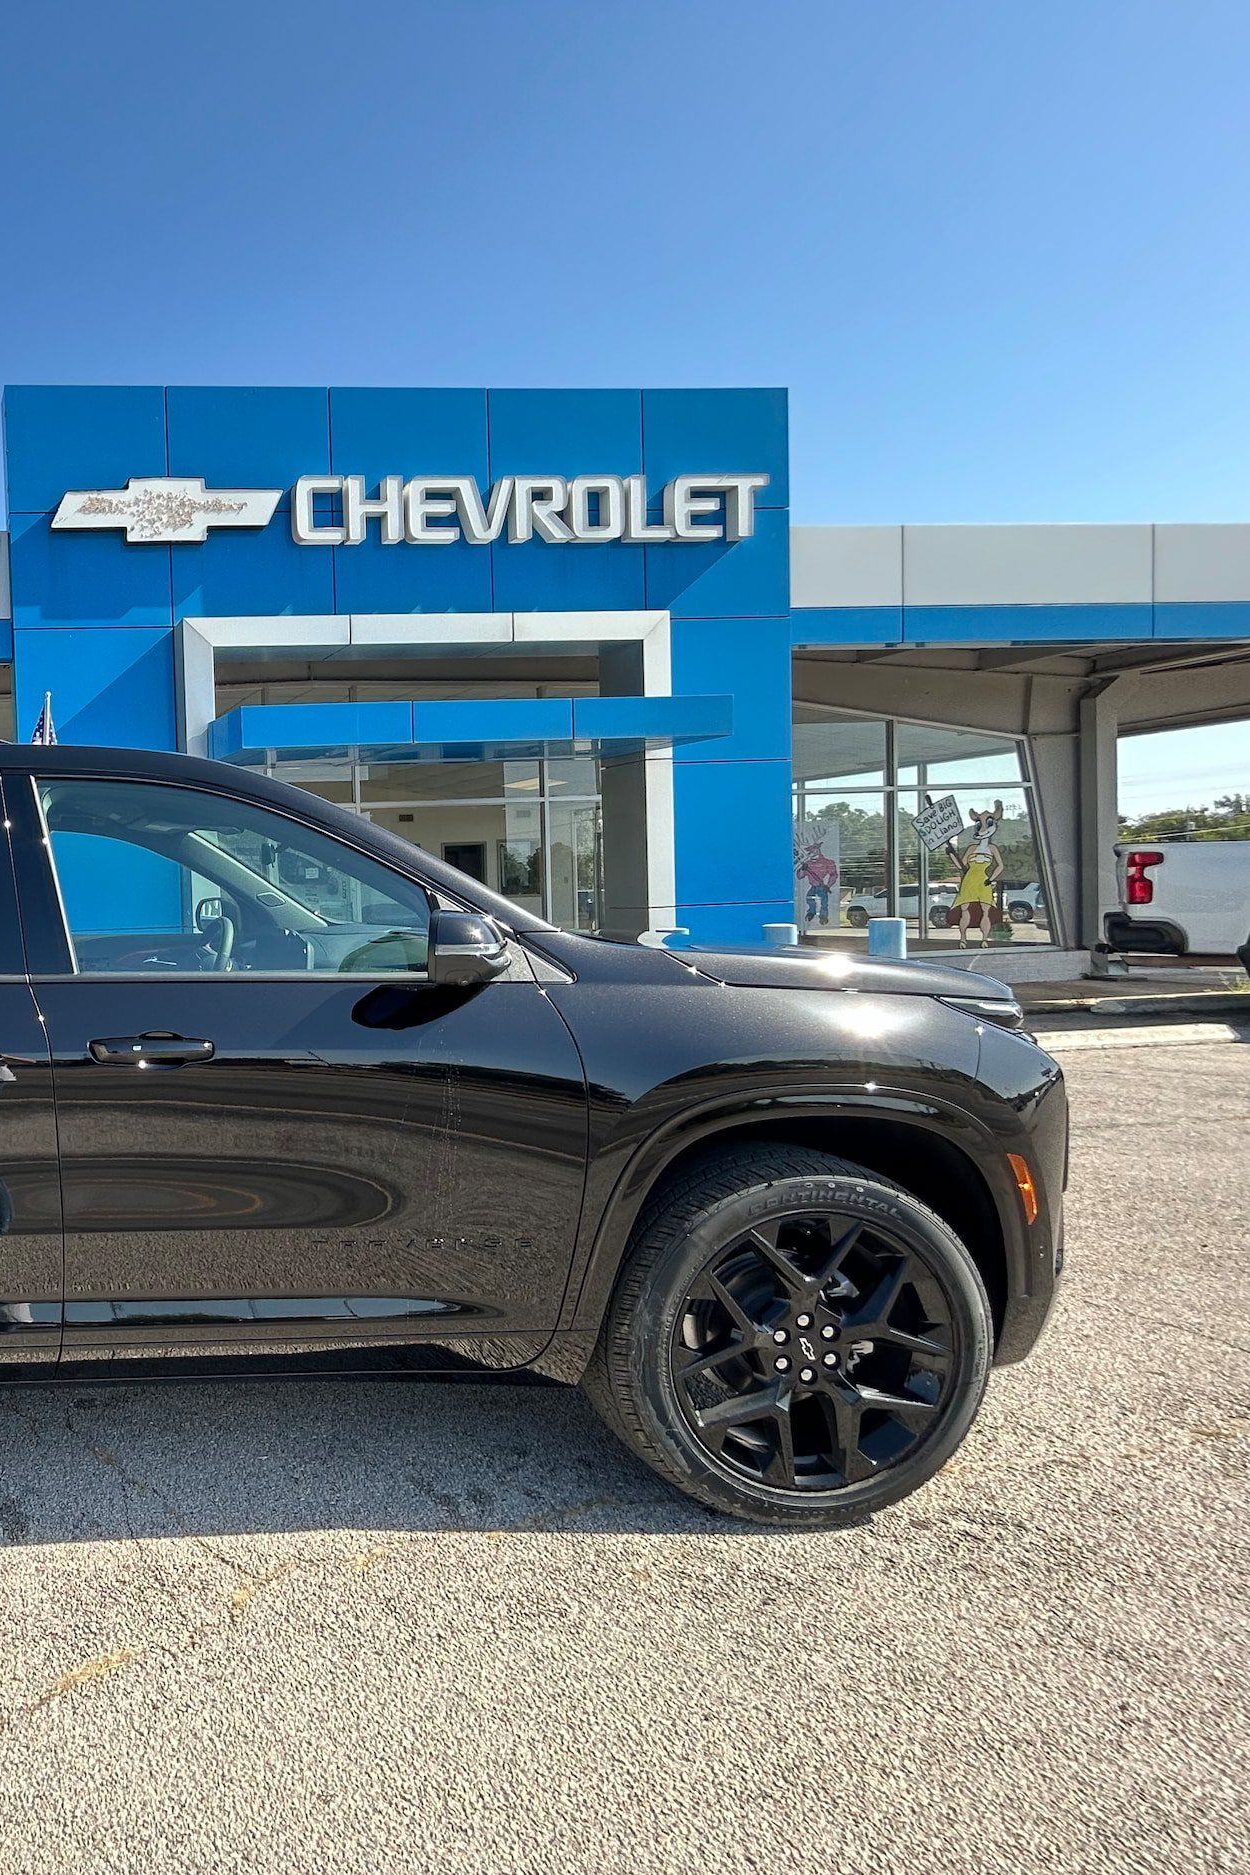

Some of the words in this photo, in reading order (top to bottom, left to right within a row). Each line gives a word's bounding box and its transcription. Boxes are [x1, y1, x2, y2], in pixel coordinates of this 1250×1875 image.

[291, 474, 770, 545] CHEVROLET
[915, 809, 937, 828] Save
[938, 798, 952, 812] BIG
